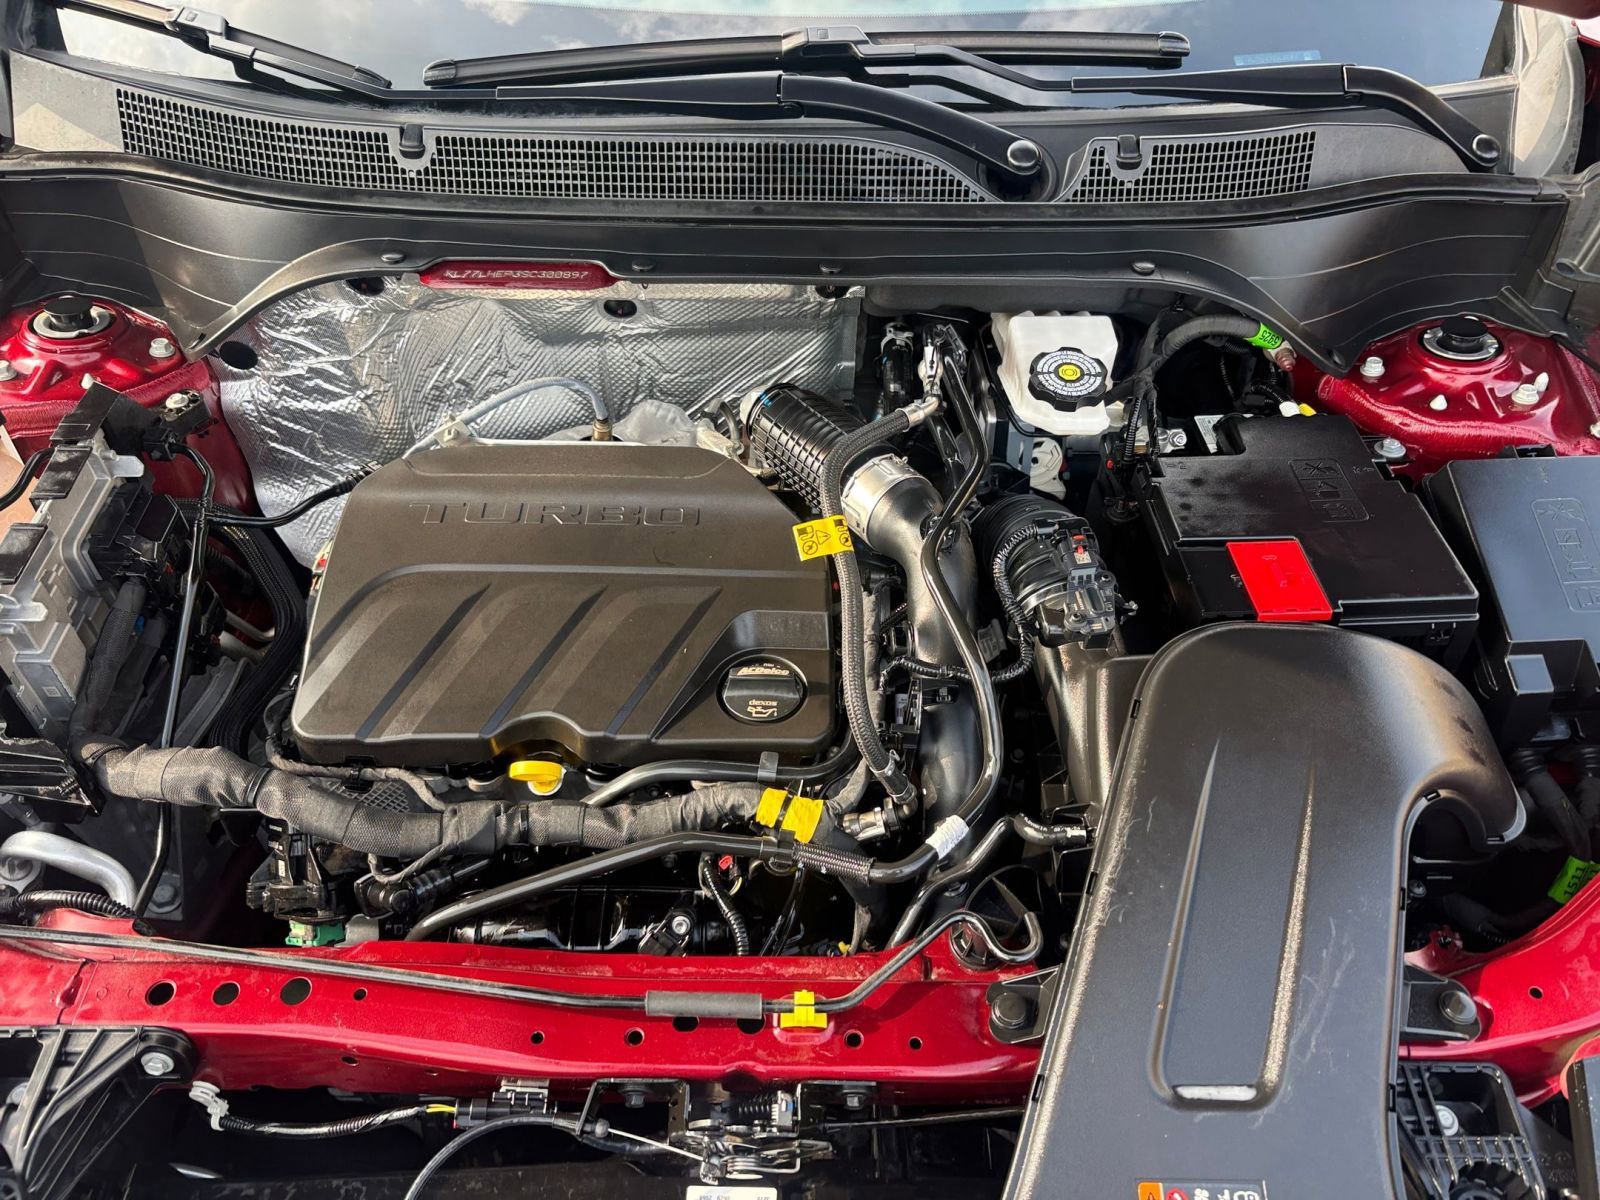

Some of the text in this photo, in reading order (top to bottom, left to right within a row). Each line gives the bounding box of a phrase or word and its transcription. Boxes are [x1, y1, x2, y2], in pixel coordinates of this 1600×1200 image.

[409, 502, 700, 526] TURBO
[737, 666, 790, 676] ACDelco
[749, 699, 778, 707] dexos
